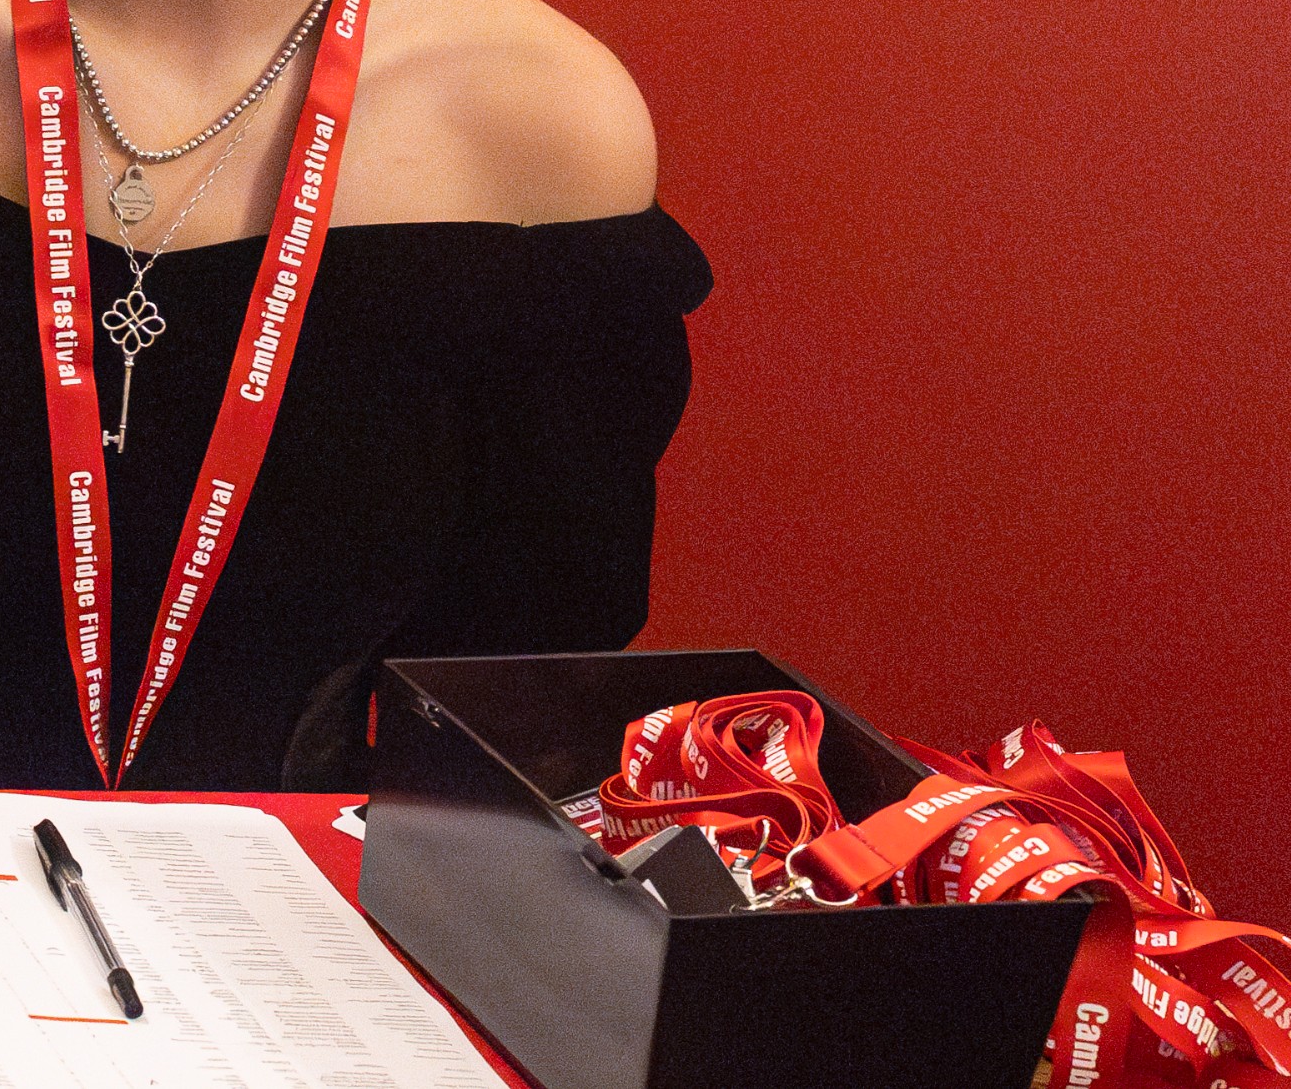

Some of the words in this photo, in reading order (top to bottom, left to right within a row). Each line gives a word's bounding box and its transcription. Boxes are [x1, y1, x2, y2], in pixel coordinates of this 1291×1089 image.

[38, 86, 68, 222] Cambridge
[293, 113, 336, 214] Festival
[48, 225, 75, 280] Film
[278, 216, 313, 268] Film
[51, 286, 82, 387] Festival
[240, 269, 298, 403] Cambridge
[69, 470, 95, 609] Cambridge
[166, 581, 199, 633] Film
[184, 479, 236, 578] Festival
[78, 612, 100, 664] Film
